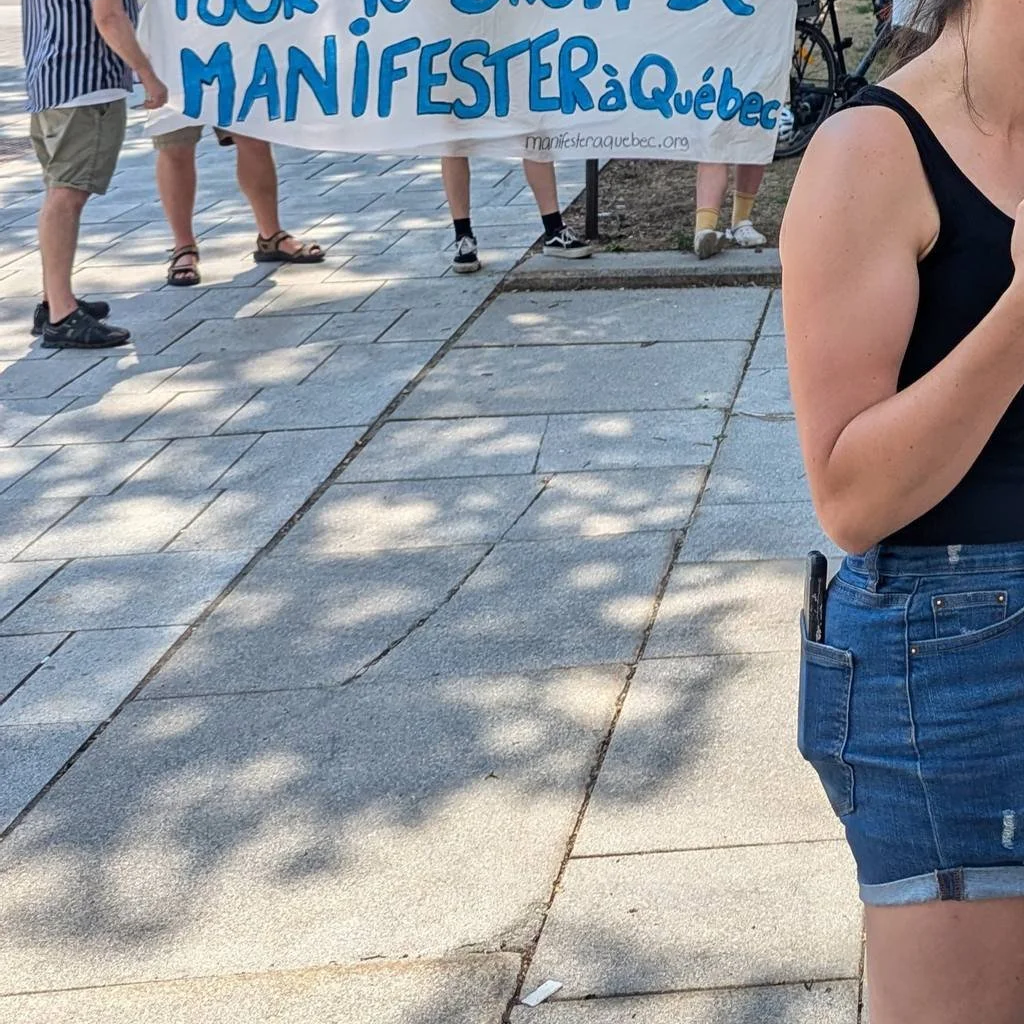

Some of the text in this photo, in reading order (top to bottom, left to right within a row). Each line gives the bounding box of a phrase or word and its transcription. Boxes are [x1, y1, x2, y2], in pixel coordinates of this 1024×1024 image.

[597, 63, 628, 112] à
[629, 53, 780, 132] Québec
[525, 131, 690, 152] manifesteraquebec.org
